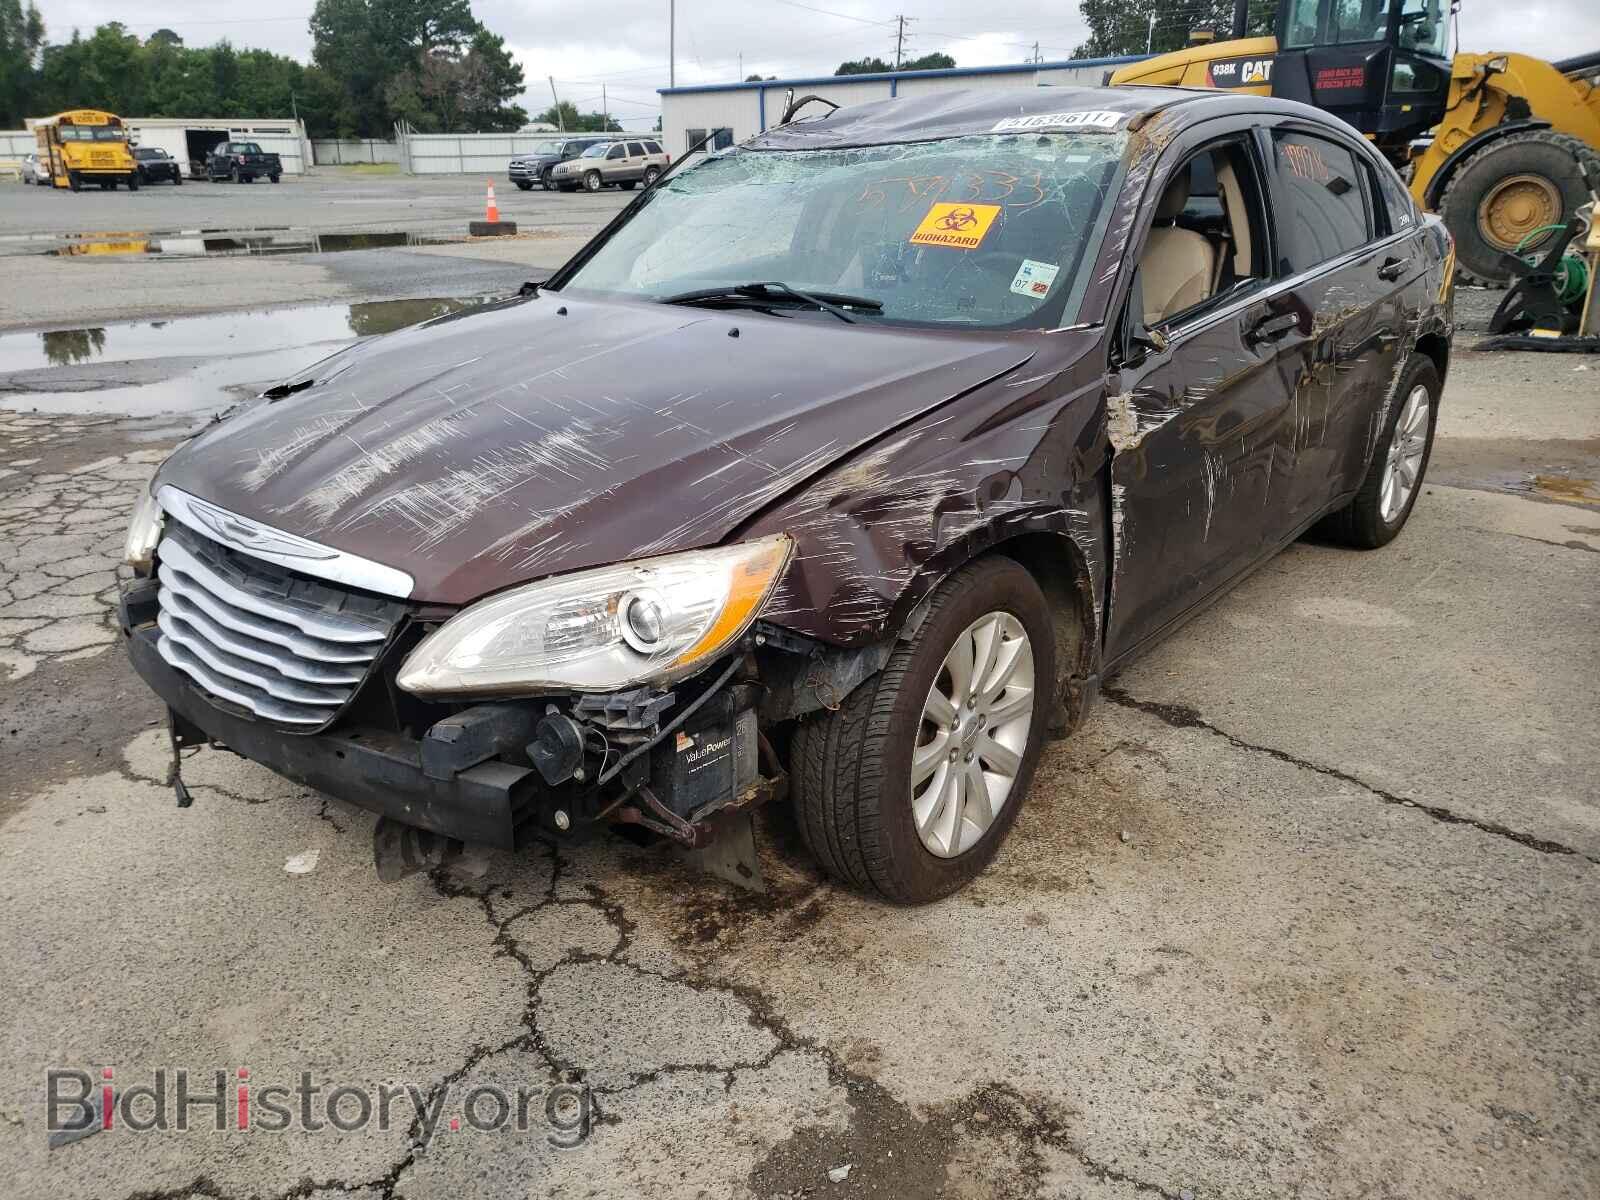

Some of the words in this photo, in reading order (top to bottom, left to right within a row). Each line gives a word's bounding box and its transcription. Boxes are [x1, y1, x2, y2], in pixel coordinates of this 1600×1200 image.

[1213, 64, 1236, 75] 938K
[1242, 60, 1273, 82] CAT
[913, 232, 978, 246] BIOHAZARD
[1015, 280, 1027, 288] 07
[1031, 282, 1047, 292] 22
[686, 737, 732, 763] ValuePower
